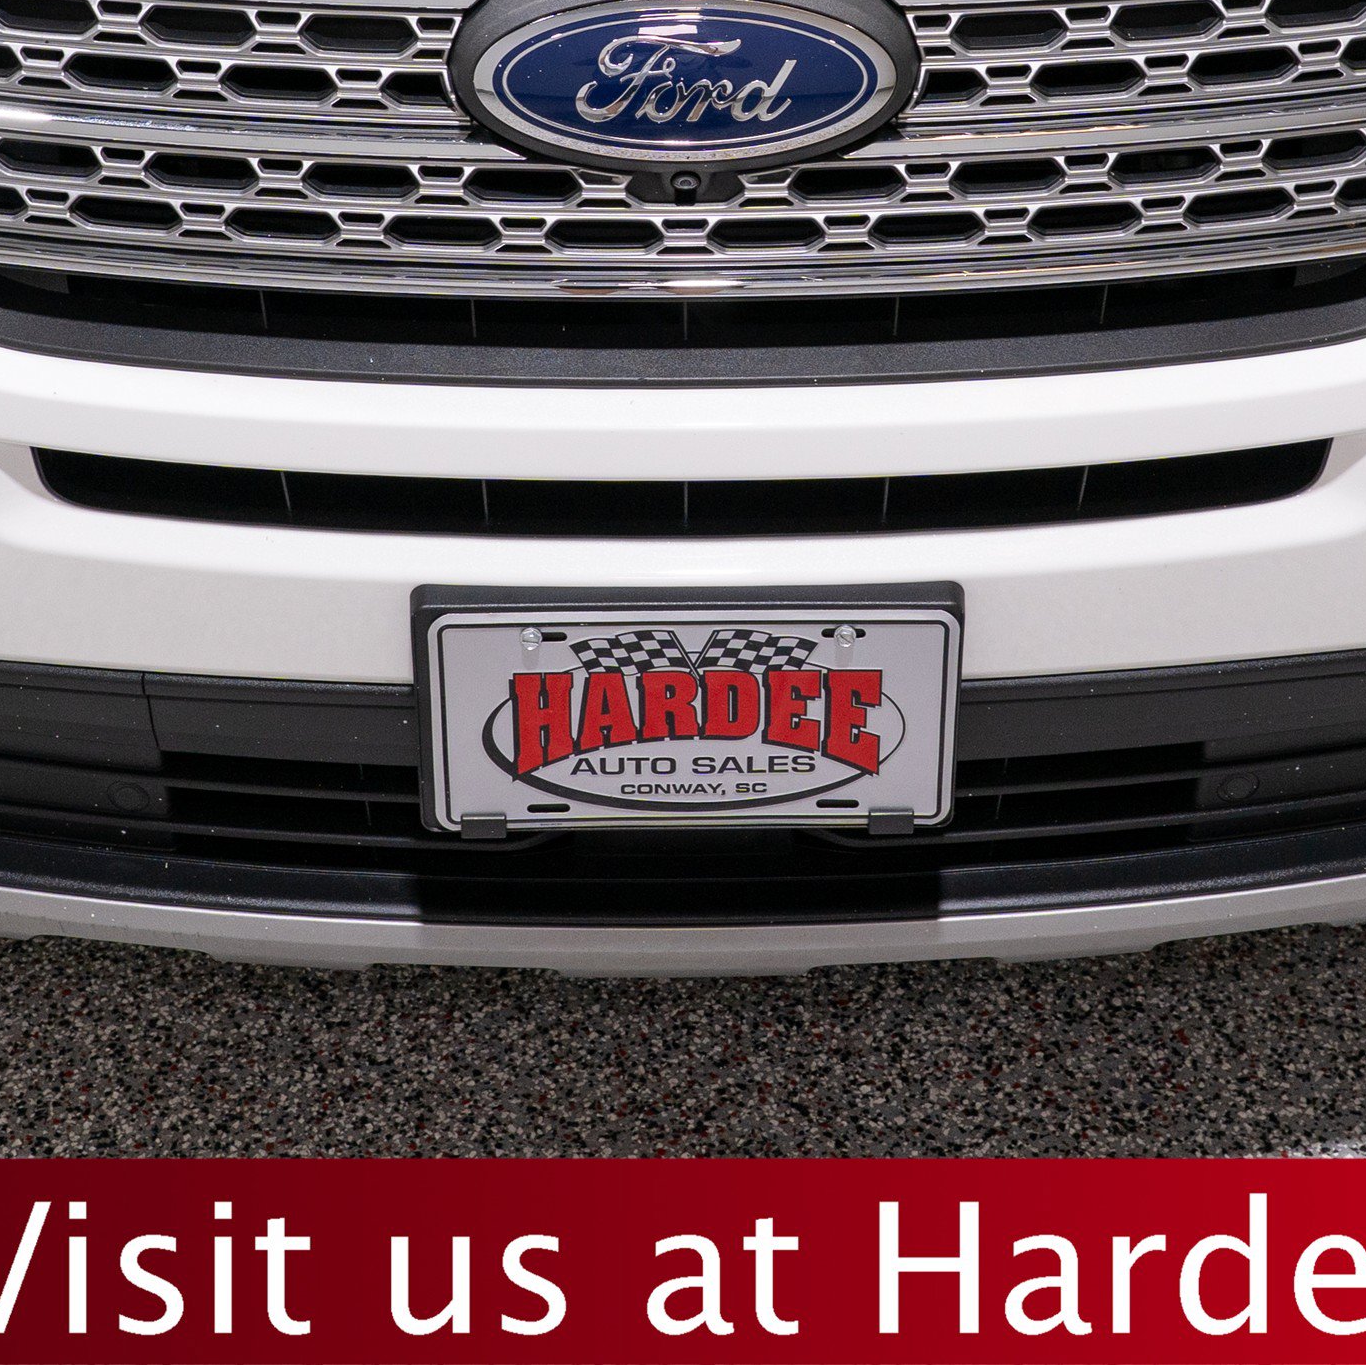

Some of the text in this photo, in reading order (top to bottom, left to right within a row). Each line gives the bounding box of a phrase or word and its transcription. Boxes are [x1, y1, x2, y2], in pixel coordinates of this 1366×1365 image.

[575, 35, 797, 123] Ford
[511, 669, 883, 777] HARDEE
[569, 753, 816, 776] AUTO SALES
[620, 781, 768, 796] CONWAY, SC
